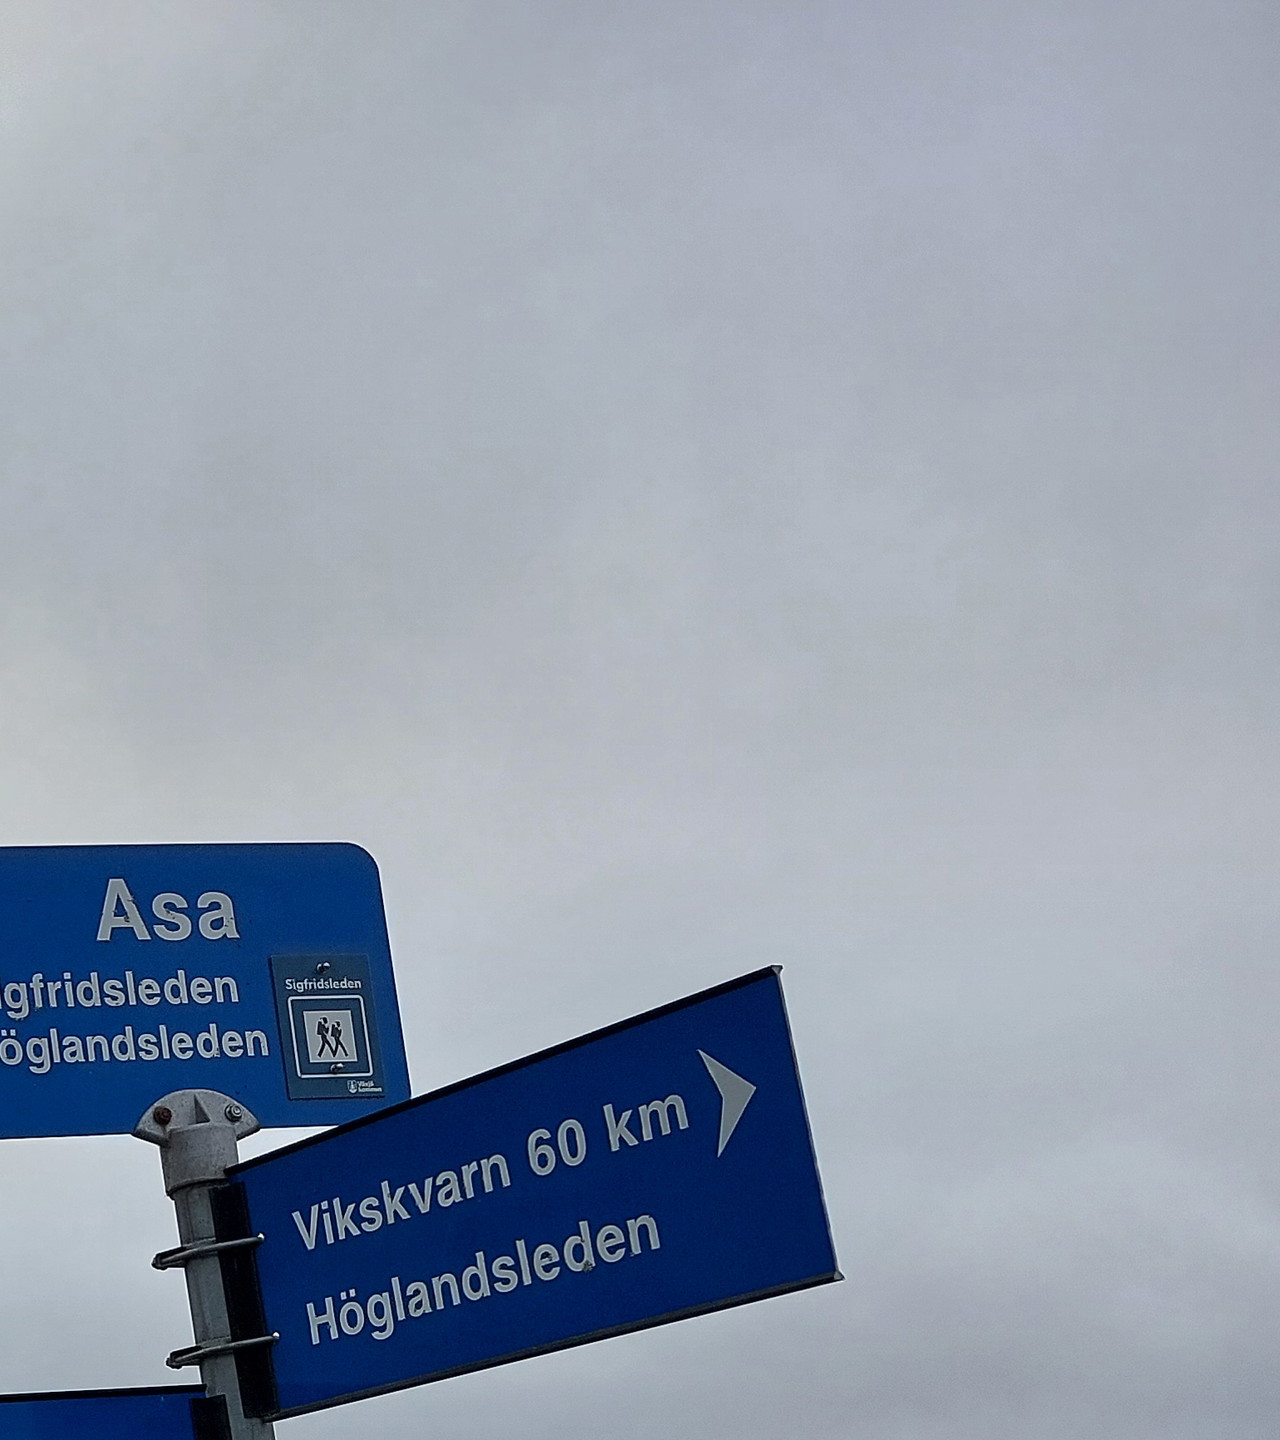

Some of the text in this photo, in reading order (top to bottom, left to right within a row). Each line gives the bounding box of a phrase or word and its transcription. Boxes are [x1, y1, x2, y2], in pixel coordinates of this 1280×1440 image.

[96, 878, 241, 942] Asa
[285, 977, 362, 993] Sigfridsleden
[291, 1091, 690, 1252] Vikskvarn 60 km
[305, 1212, 661, 1346] Höglandsleden
